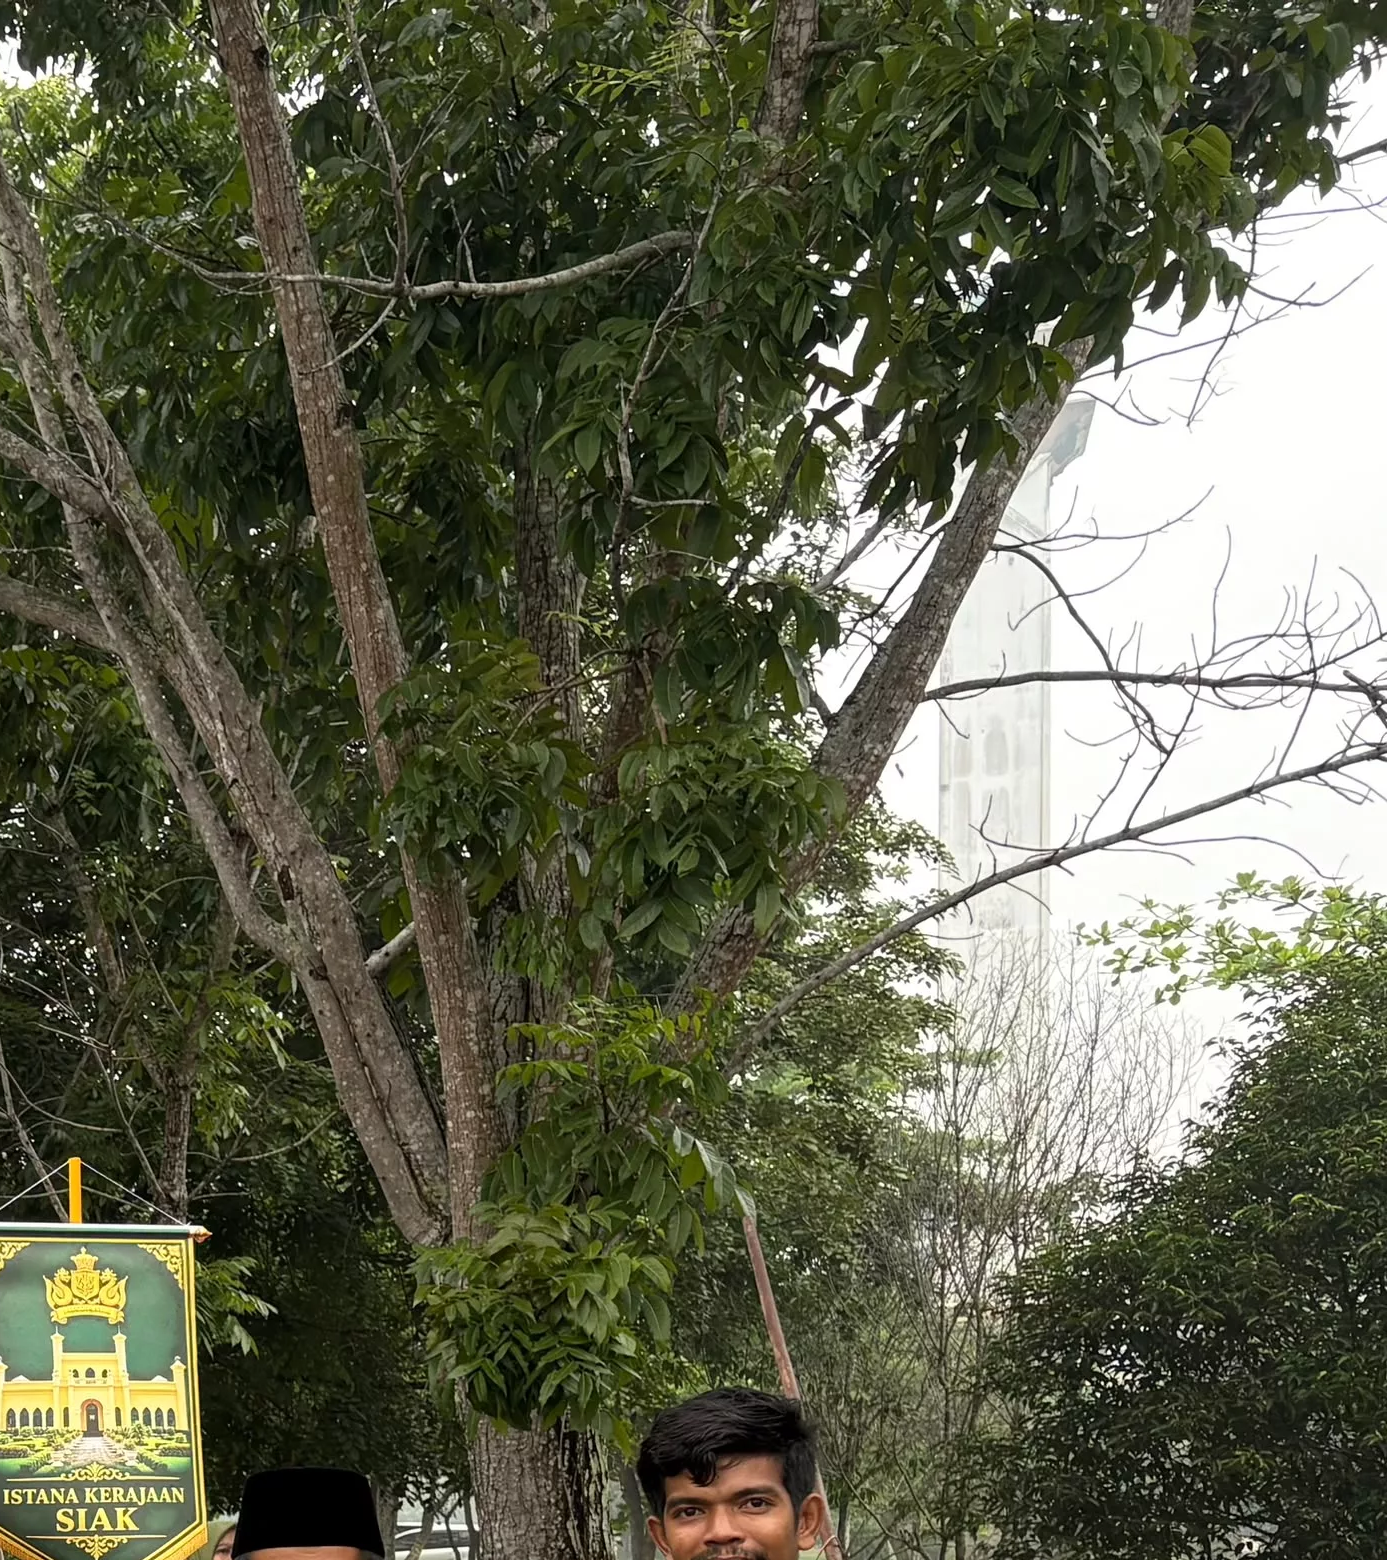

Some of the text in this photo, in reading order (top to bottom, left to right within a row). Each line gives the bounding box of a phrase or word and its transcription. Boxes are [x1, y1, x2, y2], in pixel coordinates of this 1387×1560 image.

[3, 1487, 184, 1506] ISTANA KERAJAAN
[56, 1507, 139, 1532] SIAK
